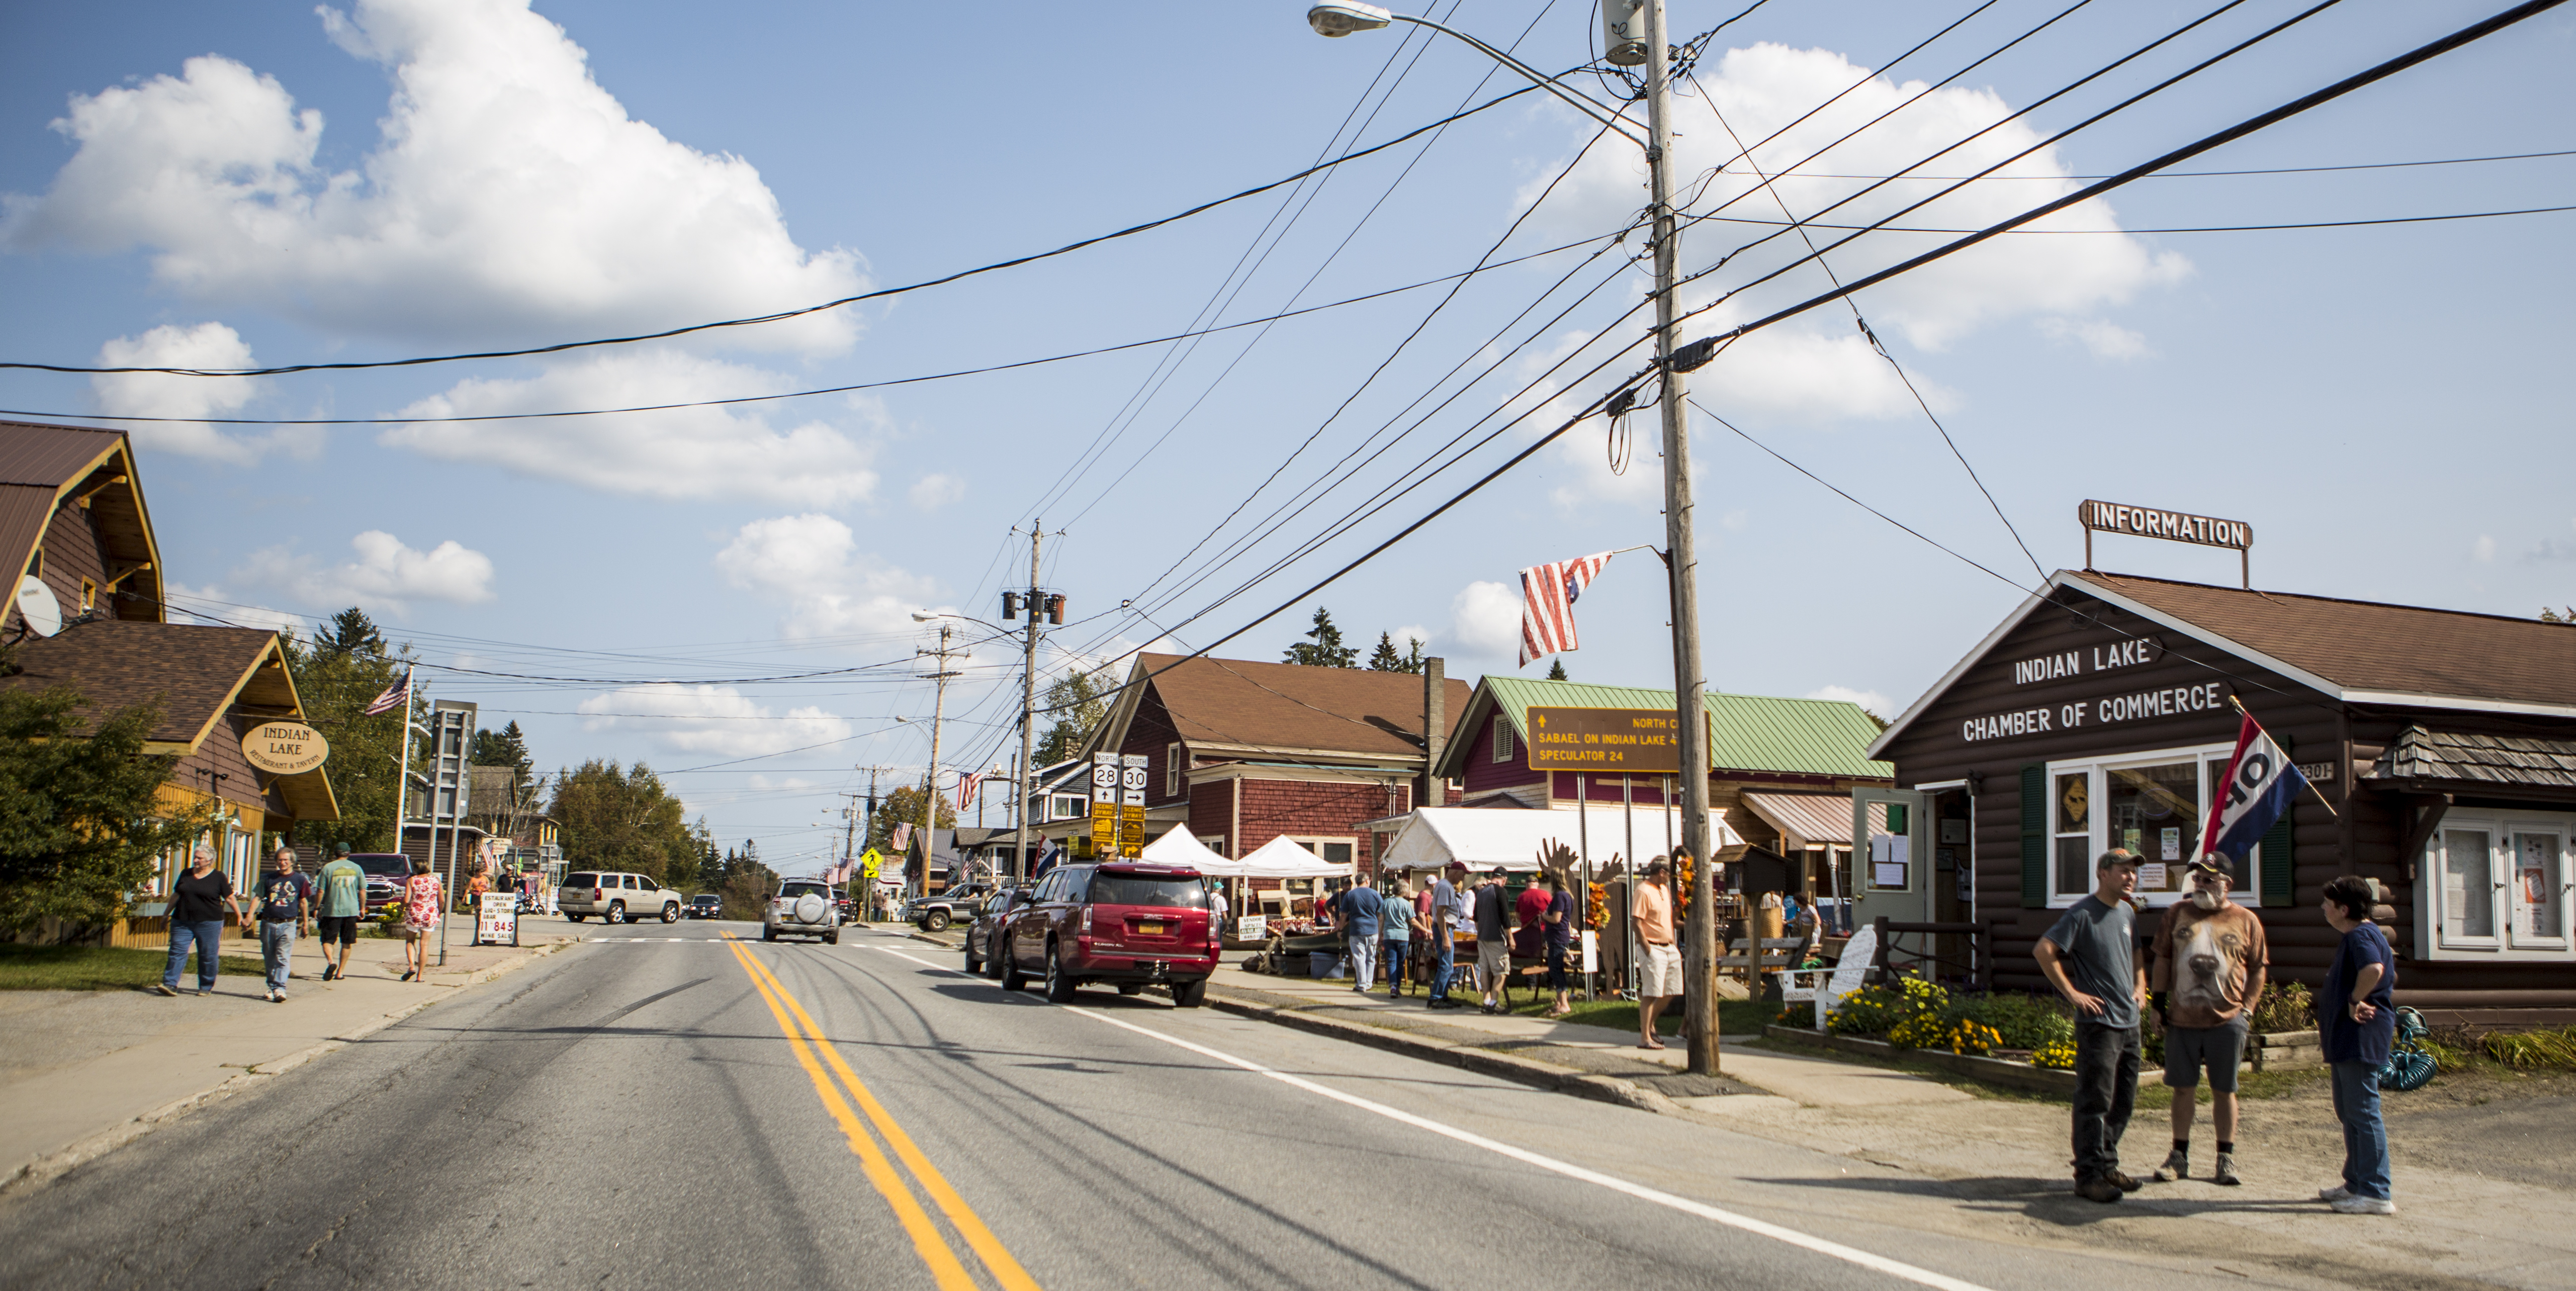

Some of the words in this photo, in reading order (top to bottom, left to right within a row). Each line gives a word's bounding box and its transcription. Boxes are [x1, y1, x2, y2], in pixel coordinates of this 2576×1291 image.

[2093, 502, 2245, 546] INFORMATION
[2016, 651, 2080, 684] INDIAN
[2094, 638, 2150, 671] LAKE
[1963, 709, 2051, 741] CHAMBER
[2062, 703, 2087, 728] OF
[2099, 682, 2221, 723] COMMERCE
[1633, 718, 1666, 729] NORTH
[264, 727, 310, 740] INDIAN
[1539, 733, 1580, 744] SABAEL
[1584, 734, 1599, 744] ON
[1602, 735, 1637, 745] INDIAN
[1640, 736, 1666, 745] LAKE
[269, 743, 302, 755] LAKE
[250, 749, 288, 769] RESTAURANT
[296, 754, 321, 768] TAVERN
[1096, 754, 1117, 763] NORTH
[1539, 750, 1605, 761] SPECULATOR
[1609, 751, 1623, 761] 24
[1097, 770, 1115, 782] 28
[1126, 772, 1145, 785] 30
